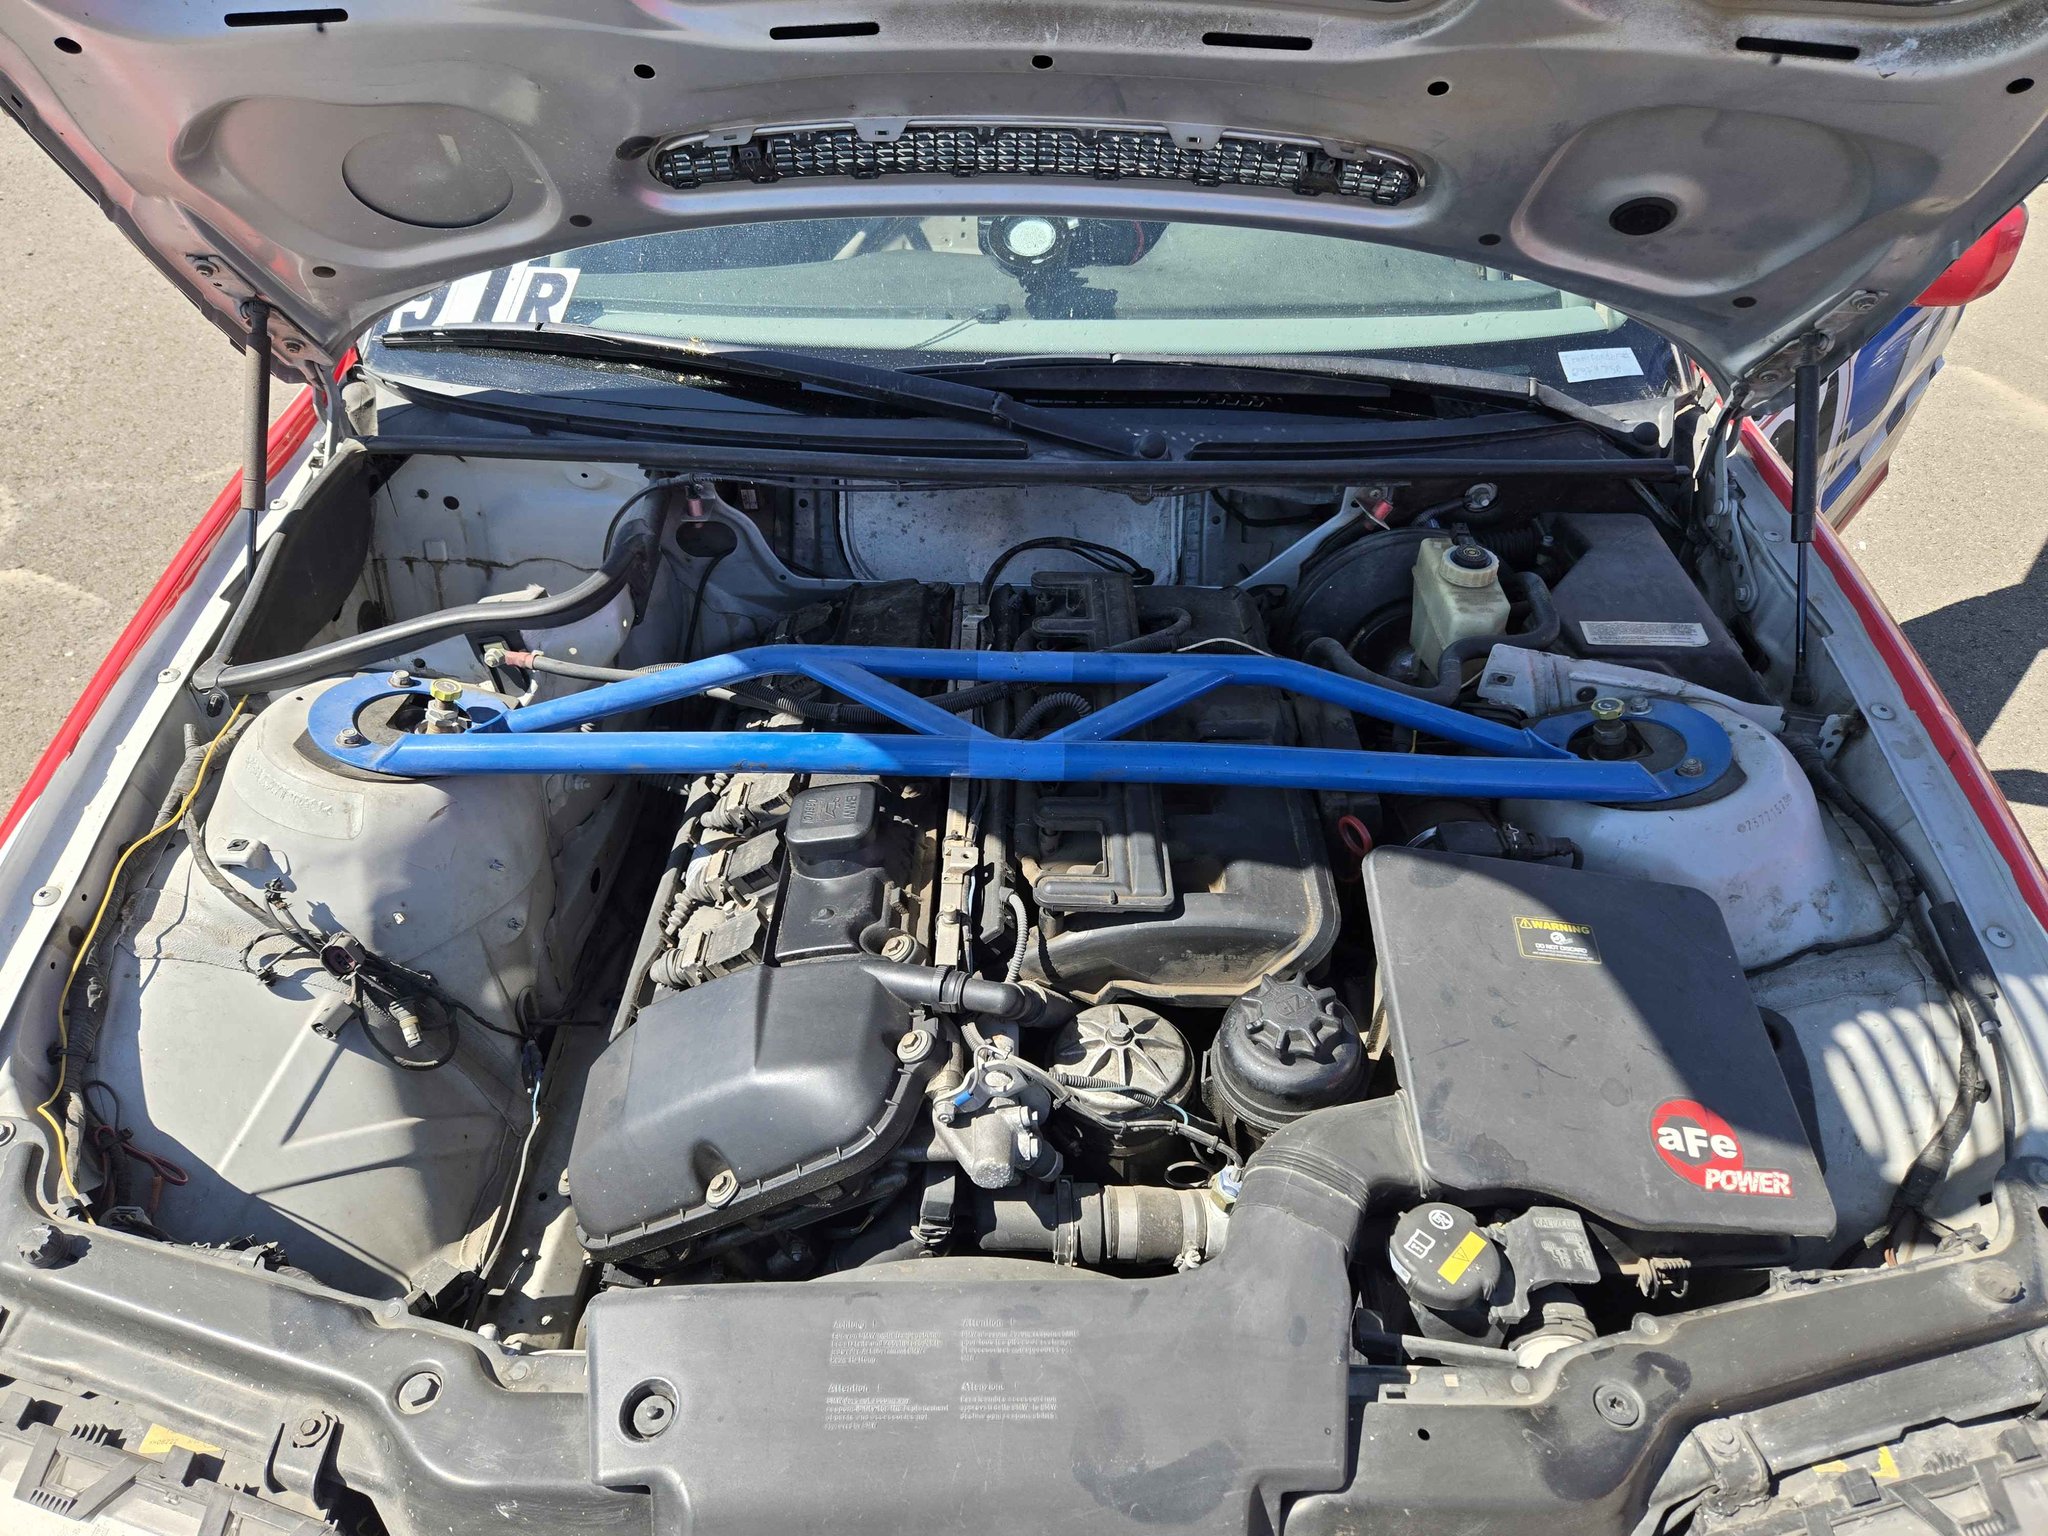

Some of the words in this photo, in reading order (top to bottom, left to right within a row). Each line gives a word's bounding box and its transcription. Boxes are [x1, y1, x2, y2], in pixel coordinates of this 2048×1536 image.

[1532, 920, 1590, 934] WARNING
[1546, 943, 1559, 951] NOT
[1657, 1126, 1738, 1159] aFe
[1705, 1168, 1791, 1195] POWER
[828, 1383, 869, 1393] Attention
